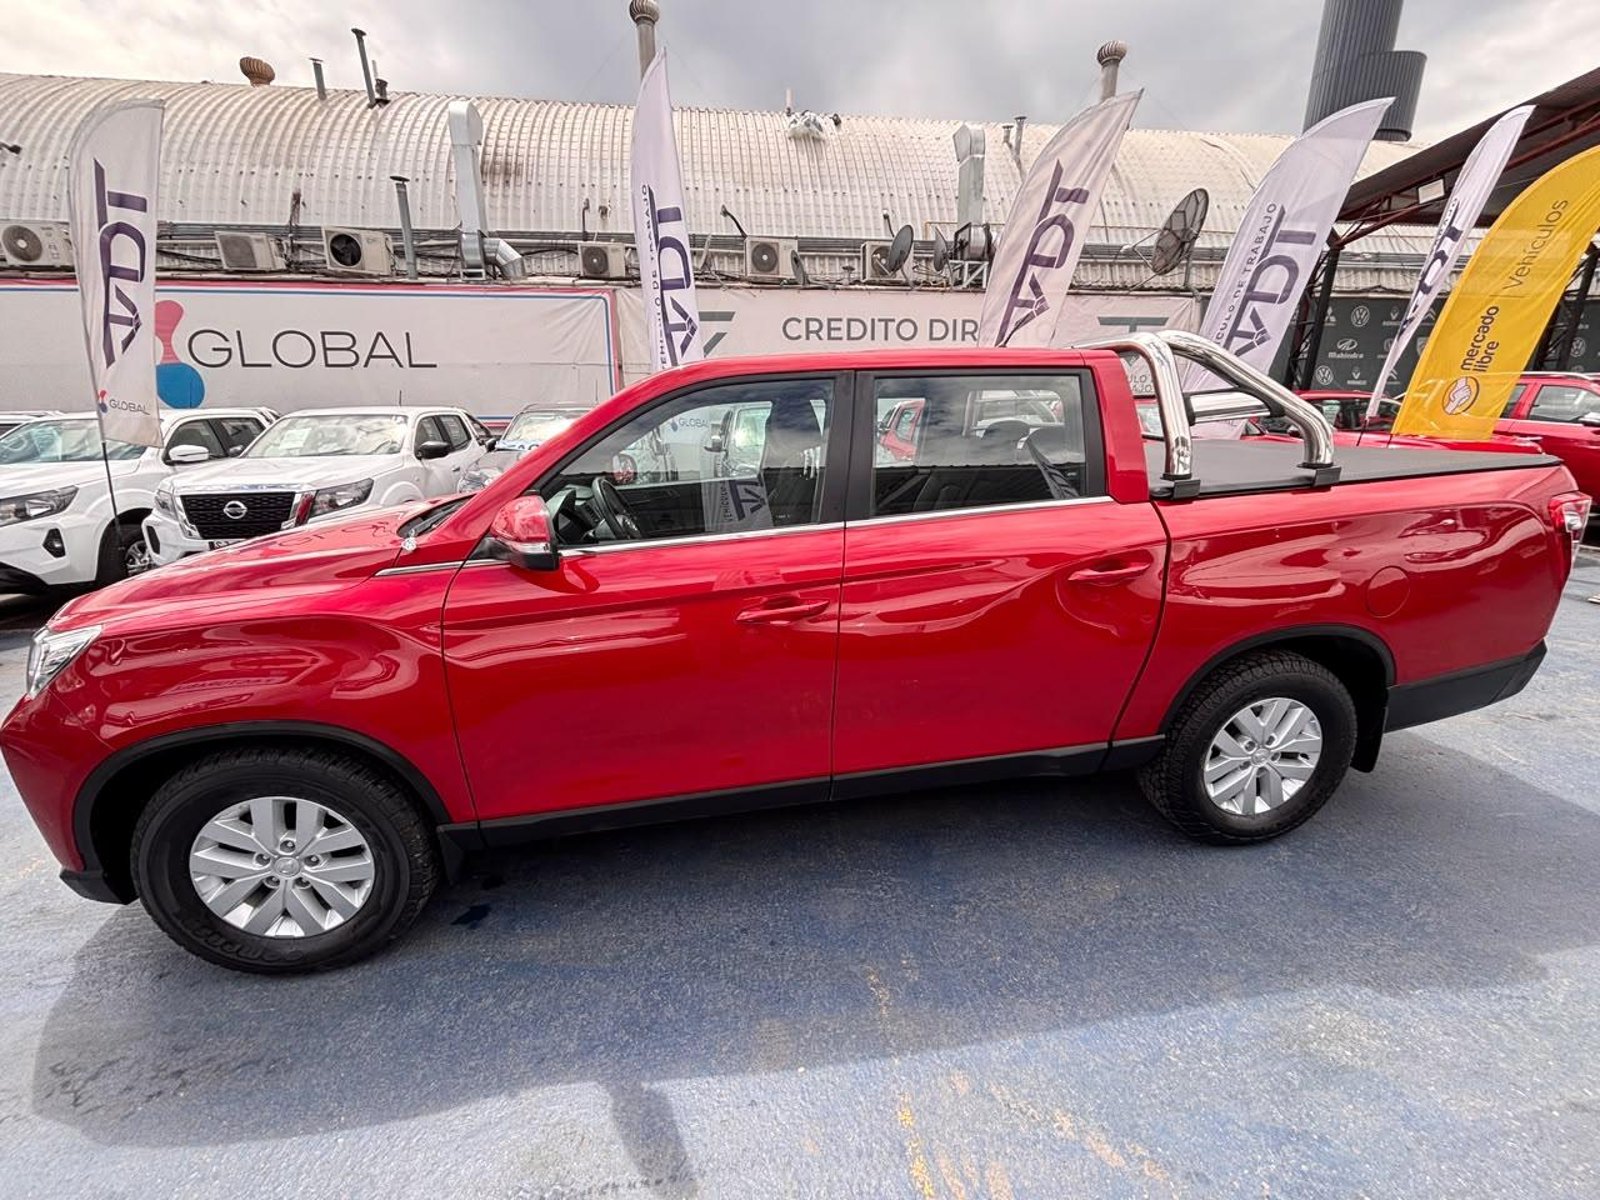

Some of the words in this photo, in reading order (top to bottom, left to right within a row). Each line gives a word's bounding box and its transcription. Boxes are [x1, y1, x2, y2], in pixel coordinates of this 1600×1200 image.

[1234, 277, 1248, 300] DE
[1244, 203, 1277, 275] TRABAJO
[651, 270, 660, 290] DE
[782, 316, 918, 342] CREDITO
[928, 316, 979, 342] DIR
[1460, 305, 1499, 371] mercado
[187, 329, 437, 369] GLOBAL
[1473, 340, 1500, 373] libre
[109, 398, 151, 416] GLOBAL
